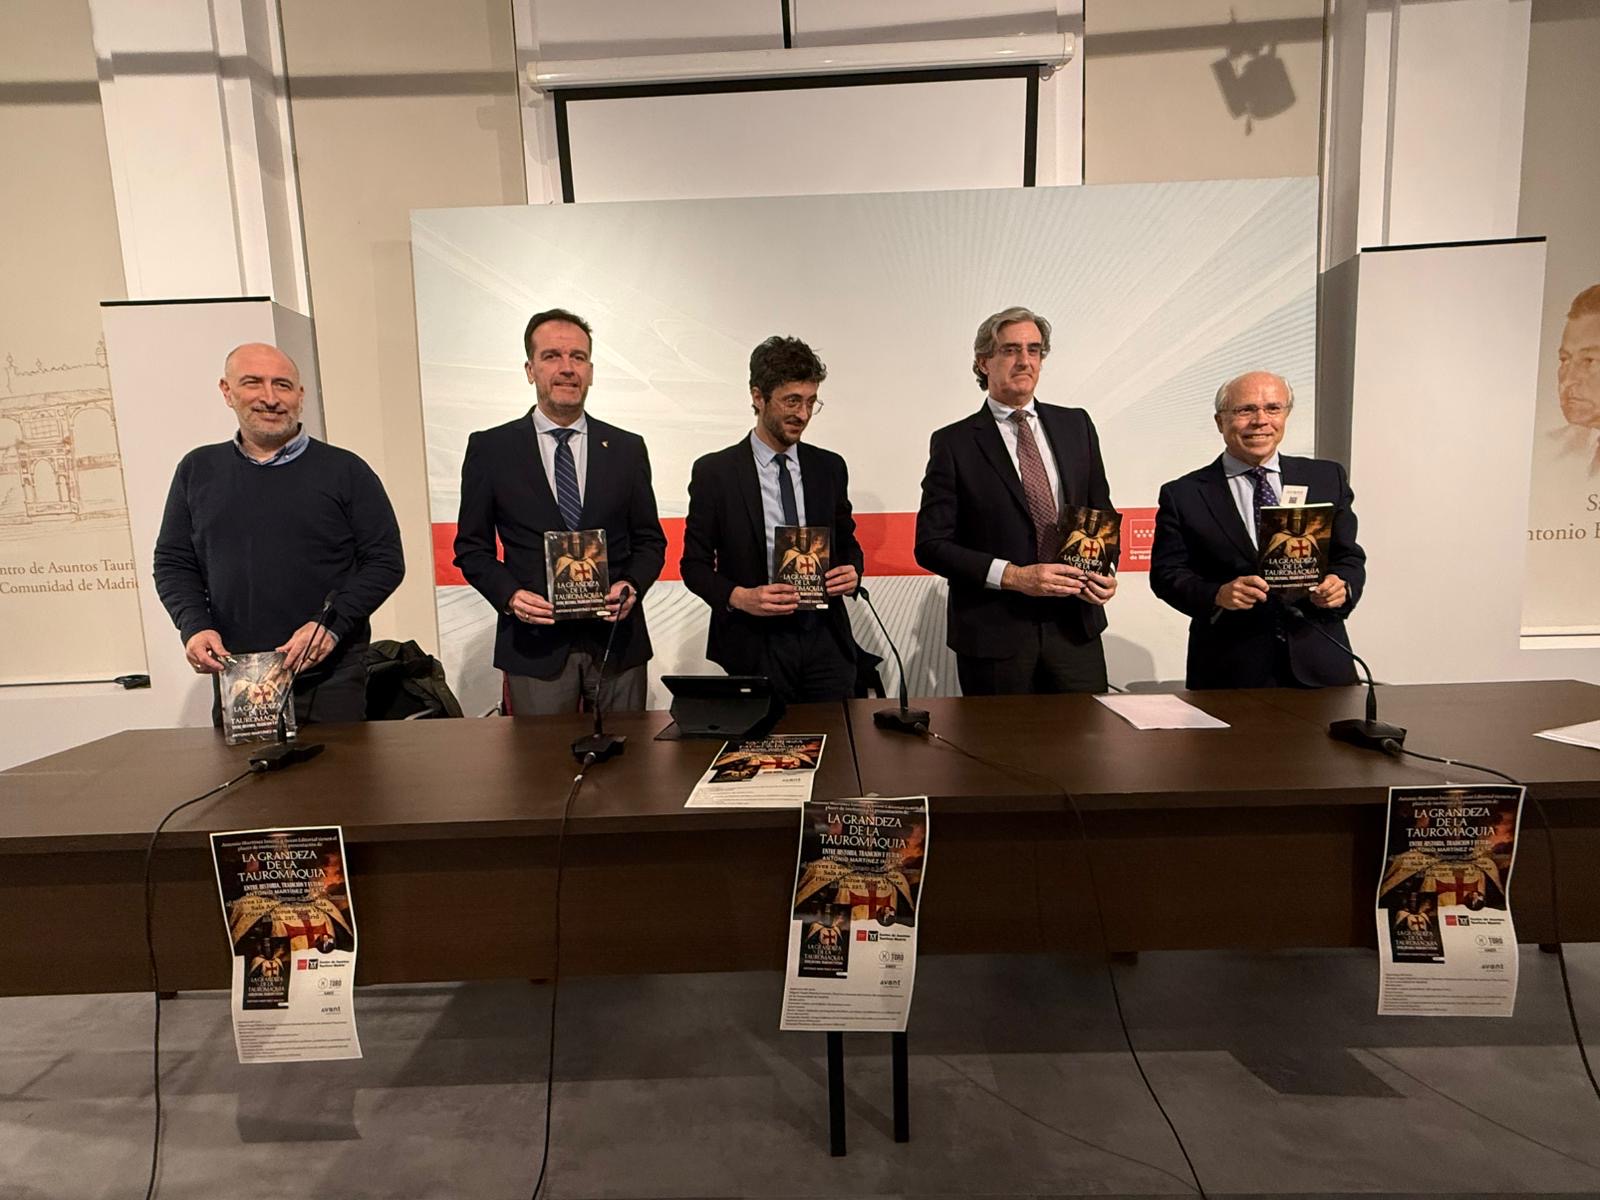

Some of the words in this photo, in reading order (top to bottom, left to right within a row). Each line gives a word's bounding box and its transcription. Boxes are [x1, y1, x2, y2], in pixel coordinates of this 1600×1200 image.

[1586, 494, 1600, 511] S
[30, 562, 44, 574] de
[48, 562, 98, 574] Asuntos
[0, 579, 74, 594] Comunidad
[78, 578, 93, 591] de
[1414, 808, 1427, 818] LA
[1429, 807, 1490, 817] GRANDEZA
[828, 814, 840, 824] LA
[842, 814, 902, 828] GRANDEZA
[1436, 818, 1451, 826] DE
[1454, 818, 1468, 826] LA
[849, 826, 864, 835] DE
[866, 827, 880, 836] LA
[1406, 826, 1496, 838] TAUROMAQUIA
[820, 834, 908, 849] TAUROMAQUIA
[242, 853, 256, 863] LA
[258, 850, 317, 861] GRANDEZA
[267, 861, 281, 869] DE
[285, 860, 298, 868] LA
[237, 868, 326, 883] TAUROMAQUIA
